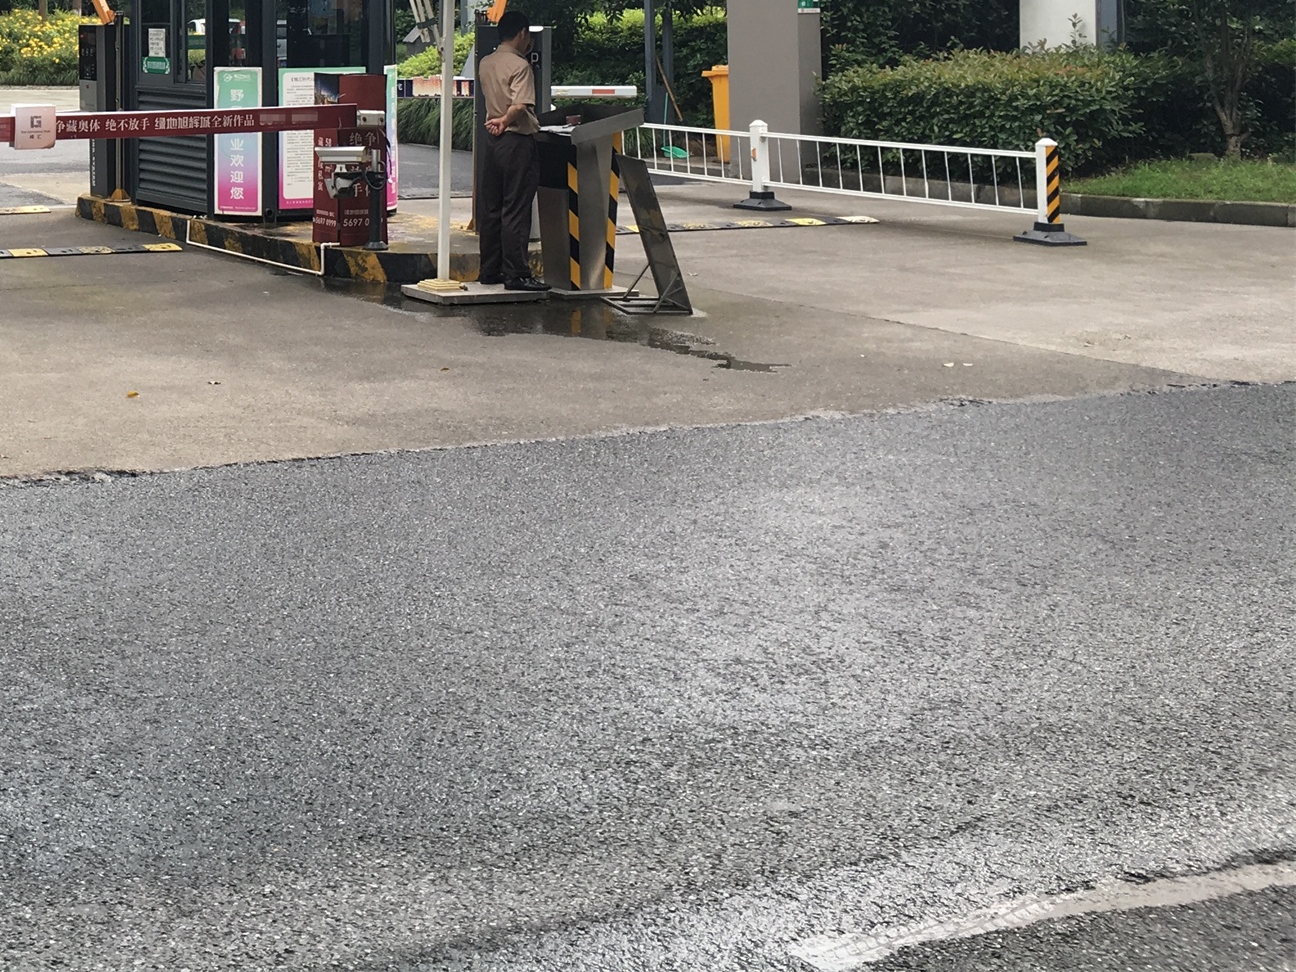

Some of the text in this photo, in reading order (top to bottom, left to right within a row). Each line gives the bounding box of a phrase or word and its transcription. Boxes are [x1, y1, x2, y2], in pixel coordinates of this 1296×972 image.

[55, 119, 101, 133] 争藏奥体
[105, 117, 150, 132] 绝不放手
[342, 218, 363, 227] 5697
